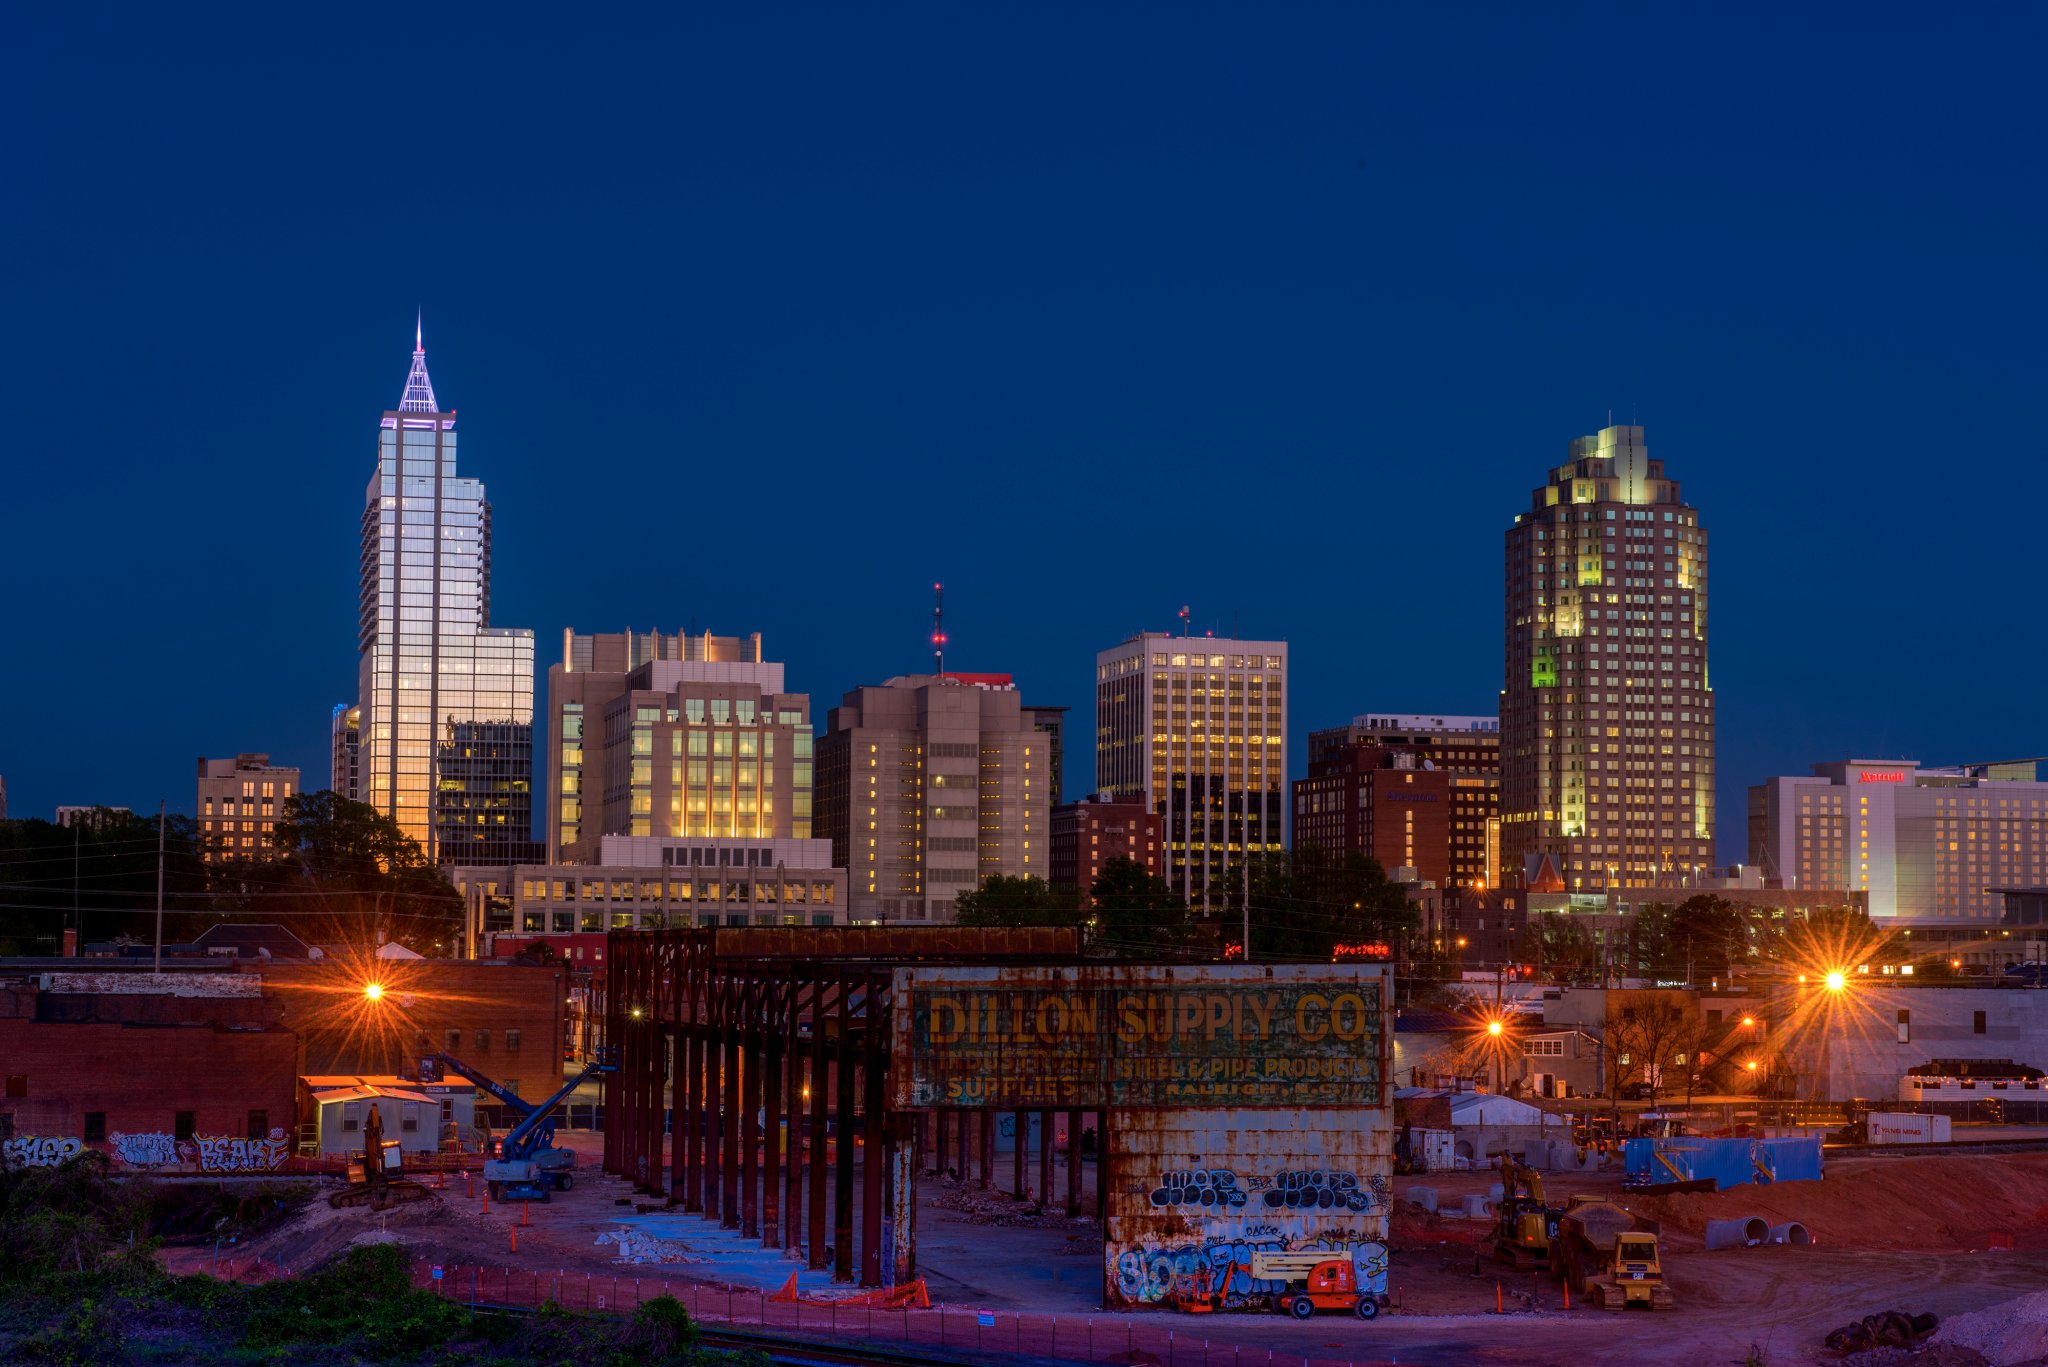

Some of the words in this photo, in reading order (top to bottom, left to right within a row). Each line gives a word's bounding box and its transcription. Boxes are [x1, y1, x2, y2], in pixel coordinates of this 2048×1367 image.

[1858, 771, 1904, 783] Marriott
[930, 997, 1097, 1044] DILLON
[1116, 993, 1281, 1042] SUPPLY
[1295, 993, 1372, 1042] CO.
[938, 1050, 1096, 1071] INDUSTRIAL
[1120, 1058, 1181, 1078] STEEL
[1189, 1059, 1204, 1078] &
[1210, 1058, 1257, 1078] PIPE
[1265, 1058, 1370, 1078] PRODUCTS
[947, 1076, 1077, 1098] SUPPLIES
[1881, 1127, 1901, 1135] YANG
